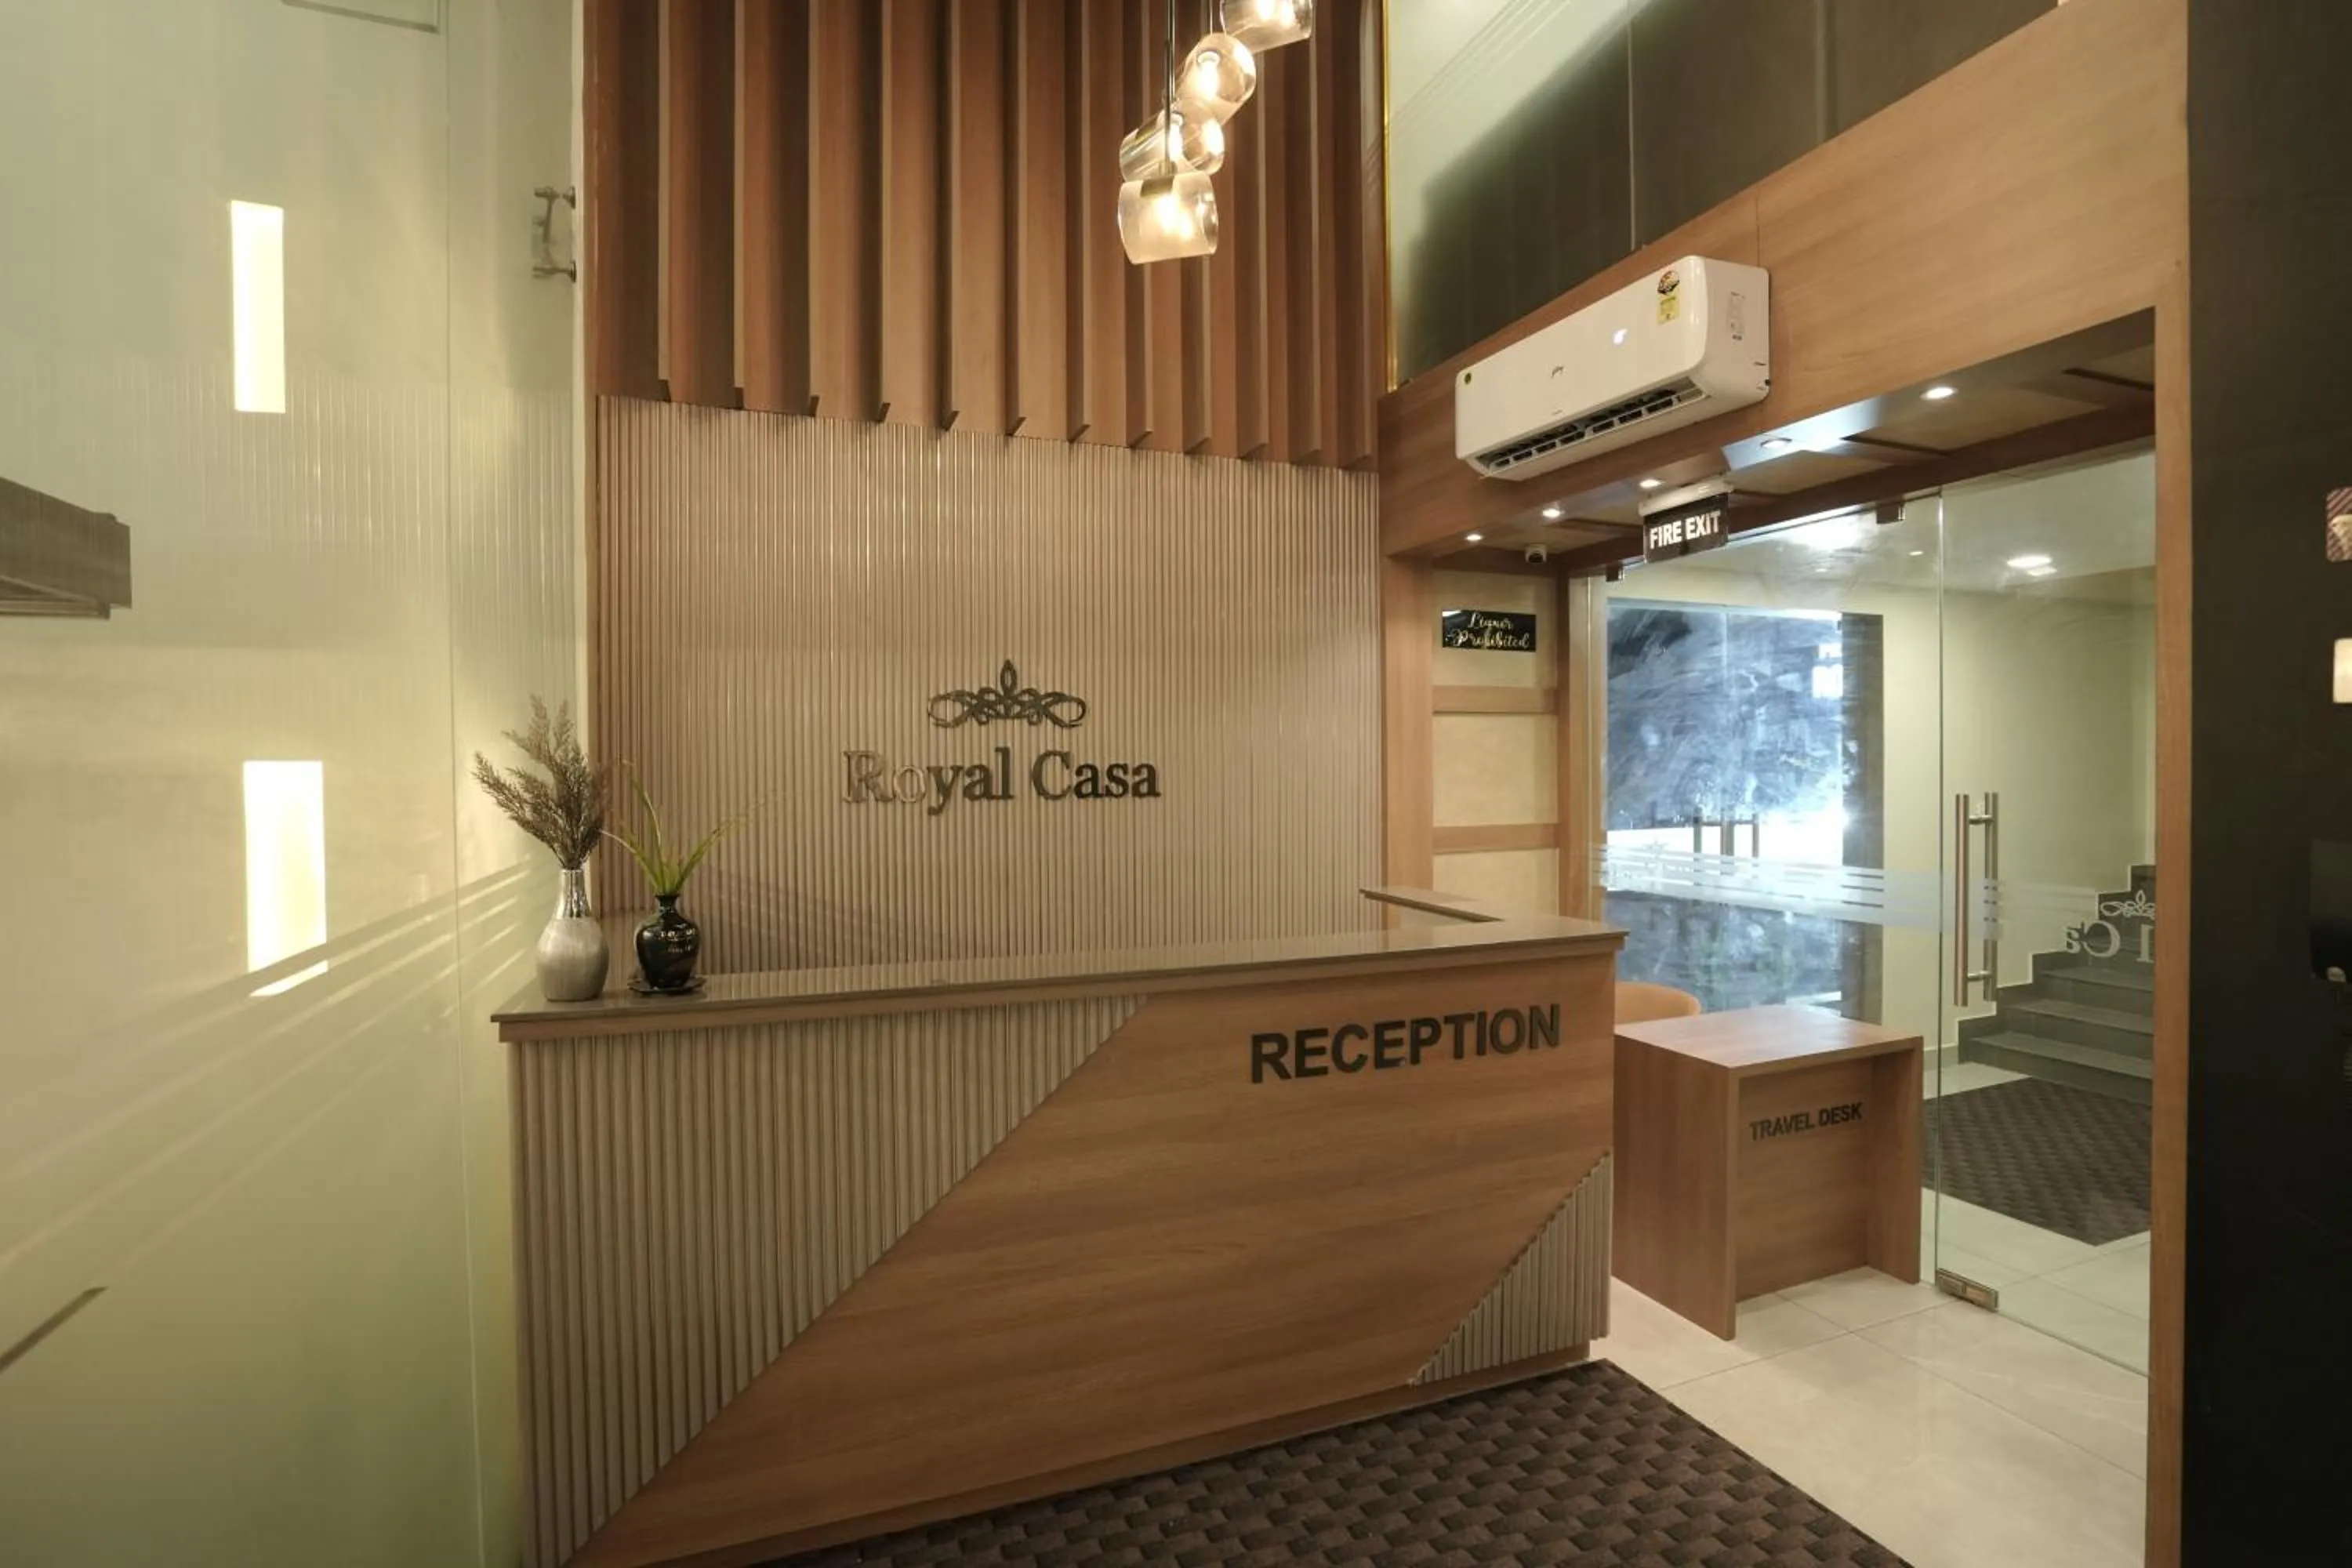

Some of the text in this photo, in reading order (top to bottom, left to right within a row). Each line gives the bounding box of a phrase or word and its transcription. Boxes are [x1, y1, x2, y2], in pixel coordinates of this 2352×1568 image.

[1649, 509, 1721, 550] FIRE EXIT
[842, 746, 1161, 816] Royal Casa
[1251, 1003, 1560, 1083] RECEPTION
[1749, 1102, 1863, 1141] TRAVEL DESK
